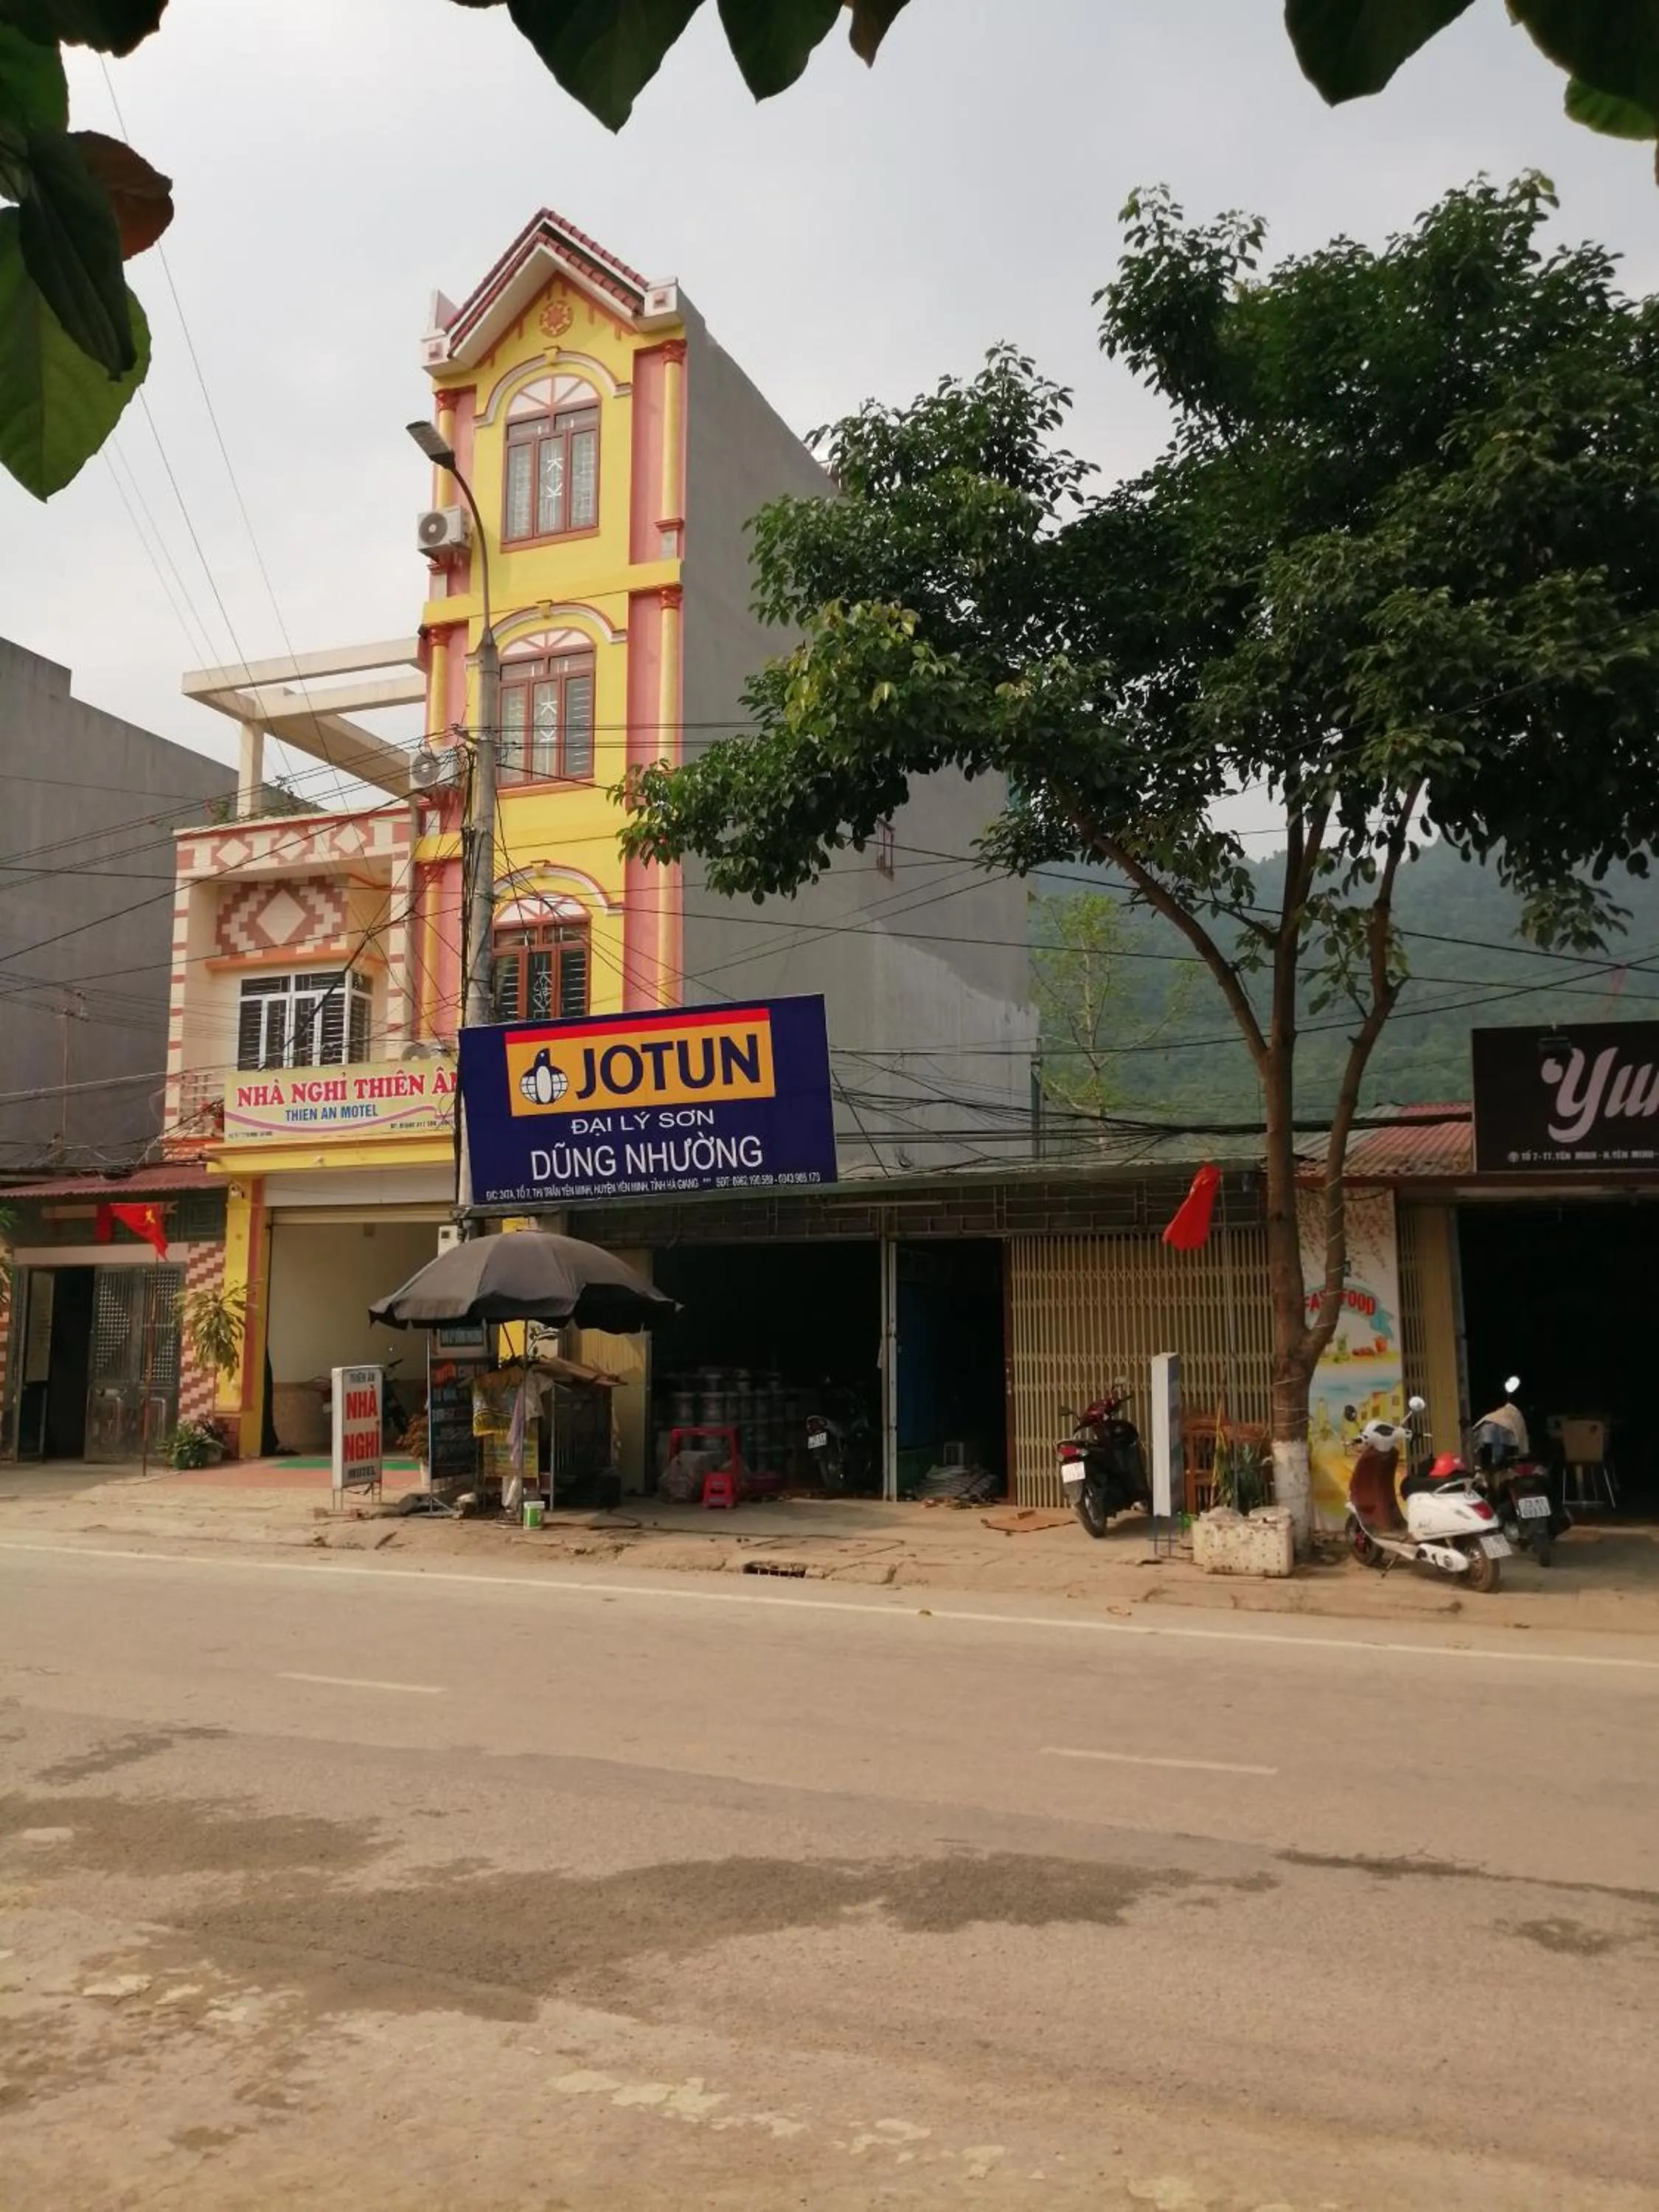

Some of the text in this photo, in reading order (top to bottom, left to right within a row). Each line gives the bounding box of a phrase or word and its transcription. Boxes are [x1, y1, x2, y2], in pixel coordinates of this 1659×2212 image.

[576, 1033, 760, 1099] JOTUN
[237, 1079, 285, 1107] NHÀ
[292, 1071, 348, 1104] NGHỈ
[354, 1069, 425, 1099] THIÊN
[285, 1104, 378, 1121] THIEN AN MOTEL
[571, 1109, 714, 1136] ĐẠI LÝ SƠN
[530, 1131, 762, 1180] DŨNG NHƯỜNG
[346, 1385, 378, 1420] NHÀ
[344, 1421, 380, 1463] NGHỈ
